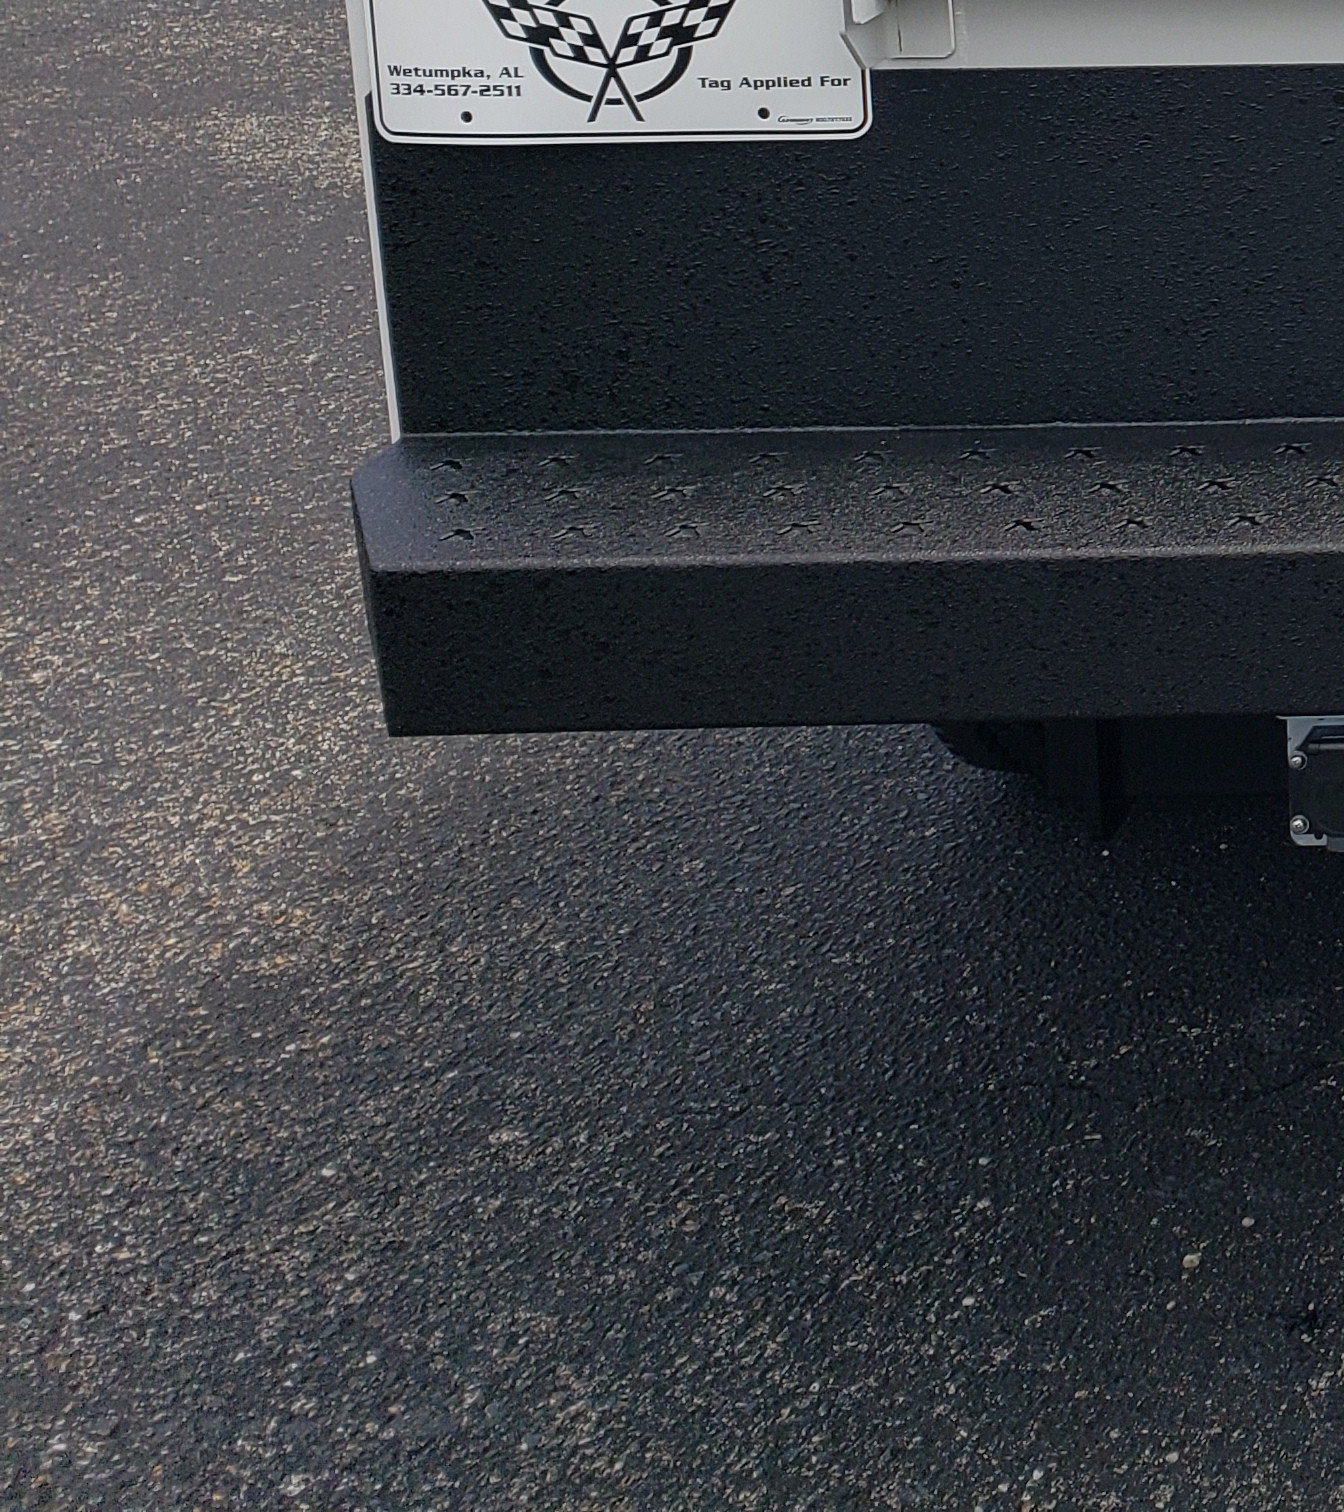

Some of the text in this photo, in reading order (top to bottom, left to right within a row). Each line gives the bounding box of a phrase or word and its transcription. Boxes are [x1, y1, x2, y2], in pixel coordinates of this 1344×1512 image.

[387, 64, 525, 80] Wetumpka, AL
[389, 82, 522, 97] 334-567-2511
[697, 75, 851, 90] Tag Applied For
